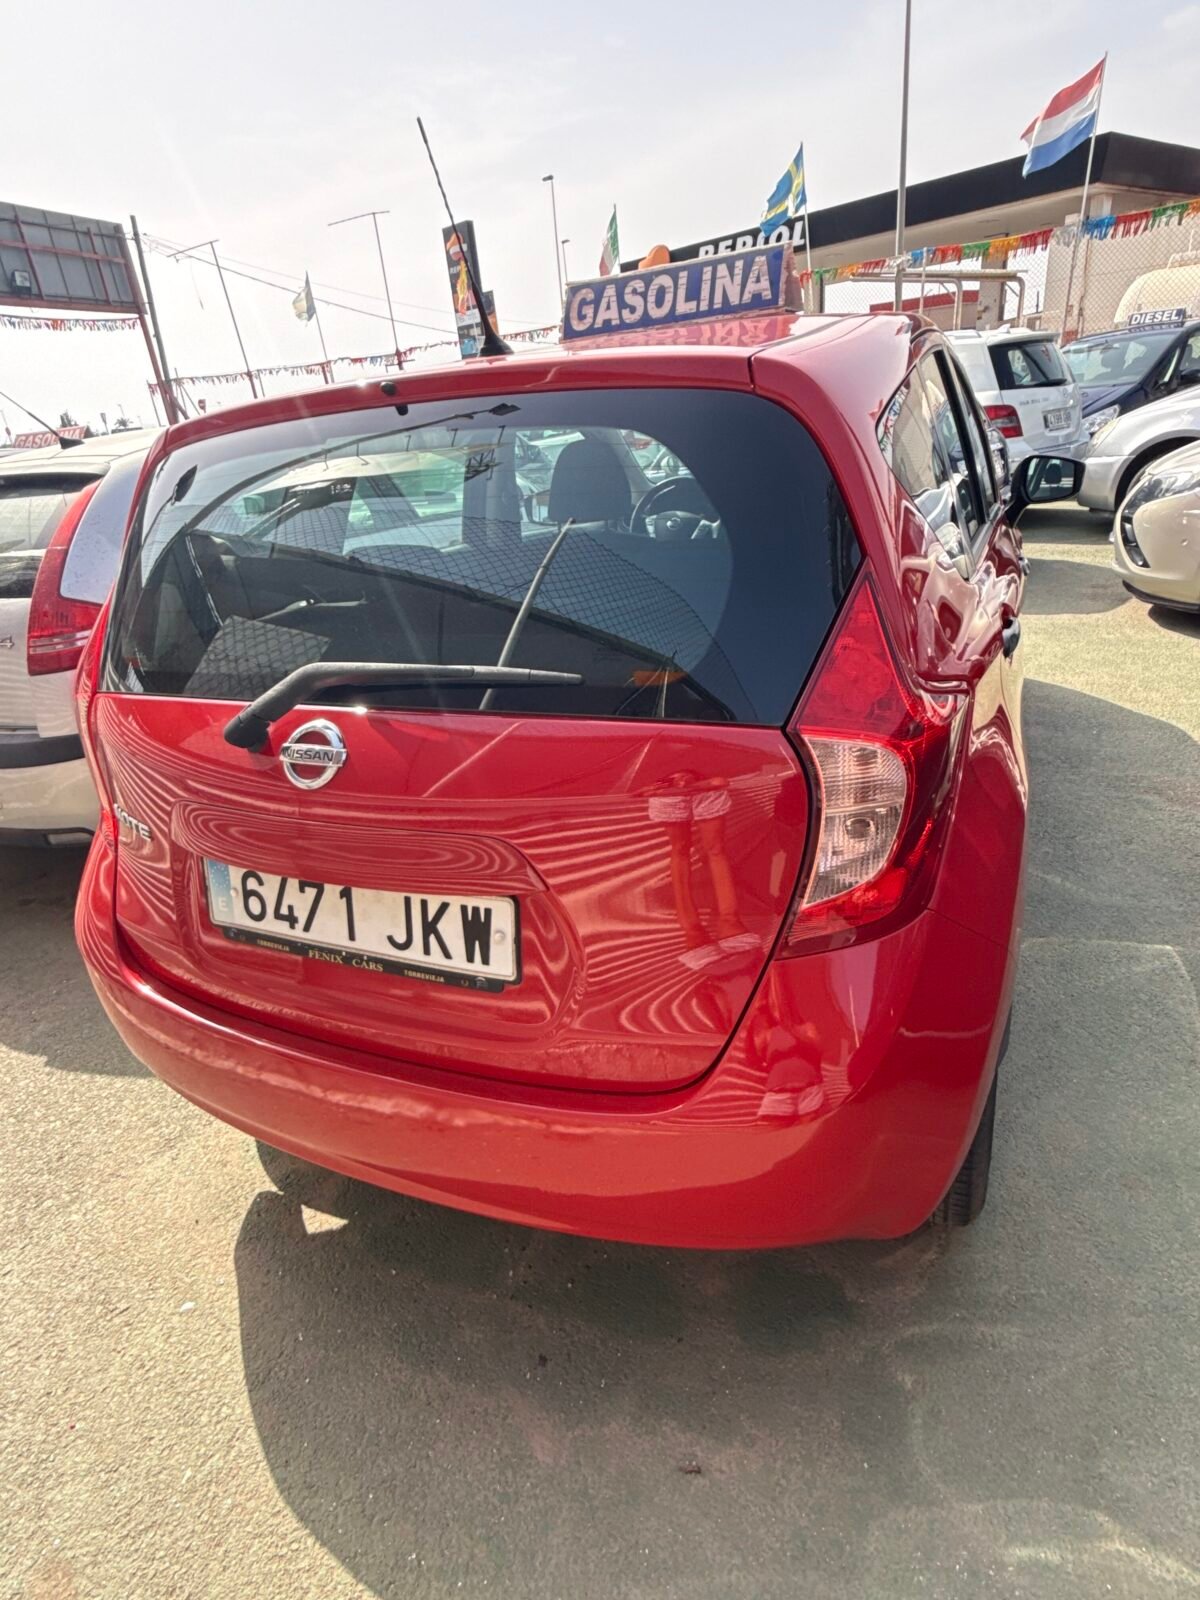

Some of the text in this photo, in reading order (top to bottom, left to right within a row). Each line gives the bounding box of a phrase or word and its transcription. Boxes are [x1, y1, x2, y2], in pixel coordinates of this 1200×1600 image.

[569, 255, 772, 331] GASOLINA
[1131, 310, 1179, 325] DIESEL
[283, 748, 334, 762] NISSAN
[218, 897, 229, 911] E
[241, 870, 492, 966] 6471 JKW
[352, 958, 383, 973] CARS
